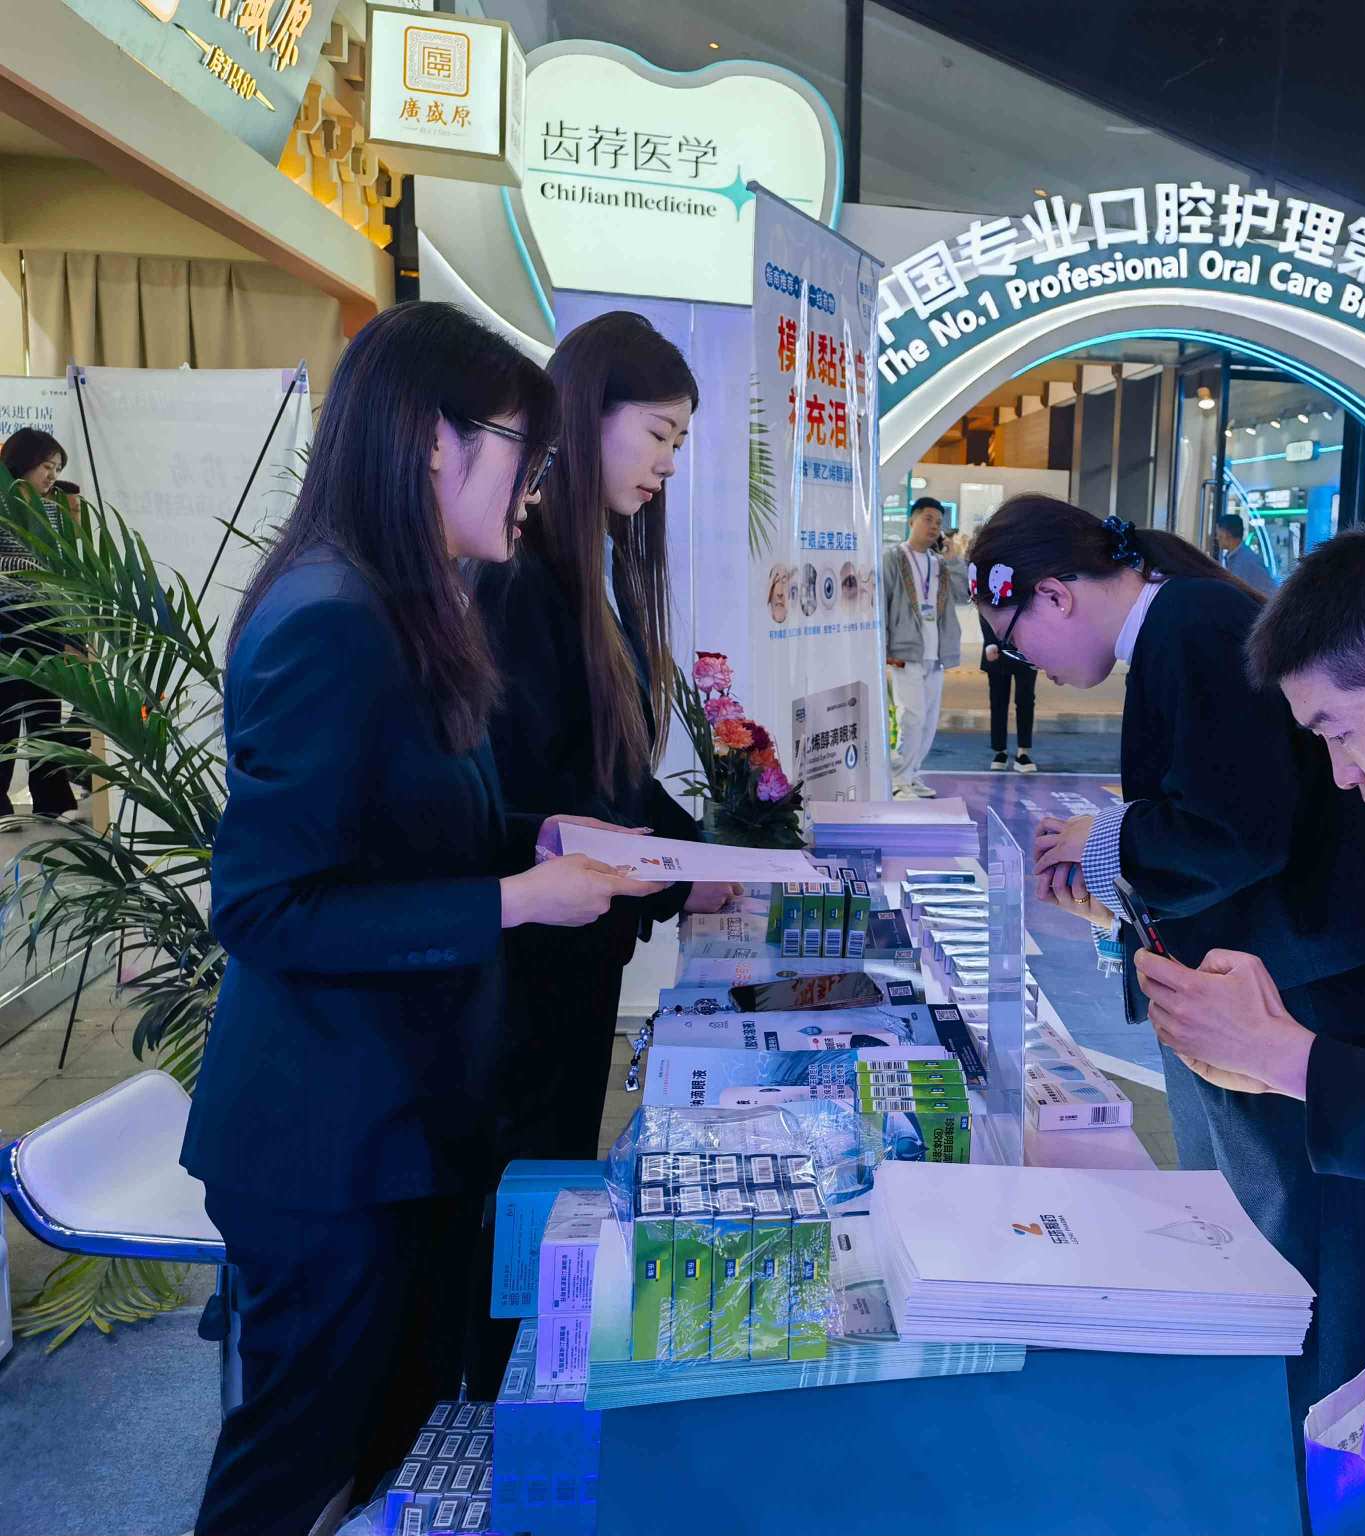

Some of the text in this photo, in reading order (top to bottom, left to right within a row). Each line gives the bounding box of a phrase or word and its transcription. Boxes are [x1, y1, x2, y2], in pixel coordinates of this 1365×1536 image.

[540, 120, 718, 178] 齿荐医学
[540, 181, 717, 217] ChiJian Medicine
[877, 334, 930, 384] The
[929, 290, 1003, 347] No.1
[1007, 249, 1188, 311] Professional
[1199, 249, 1258, 287] Oral
[1271, 259, 1333, 305] Care
